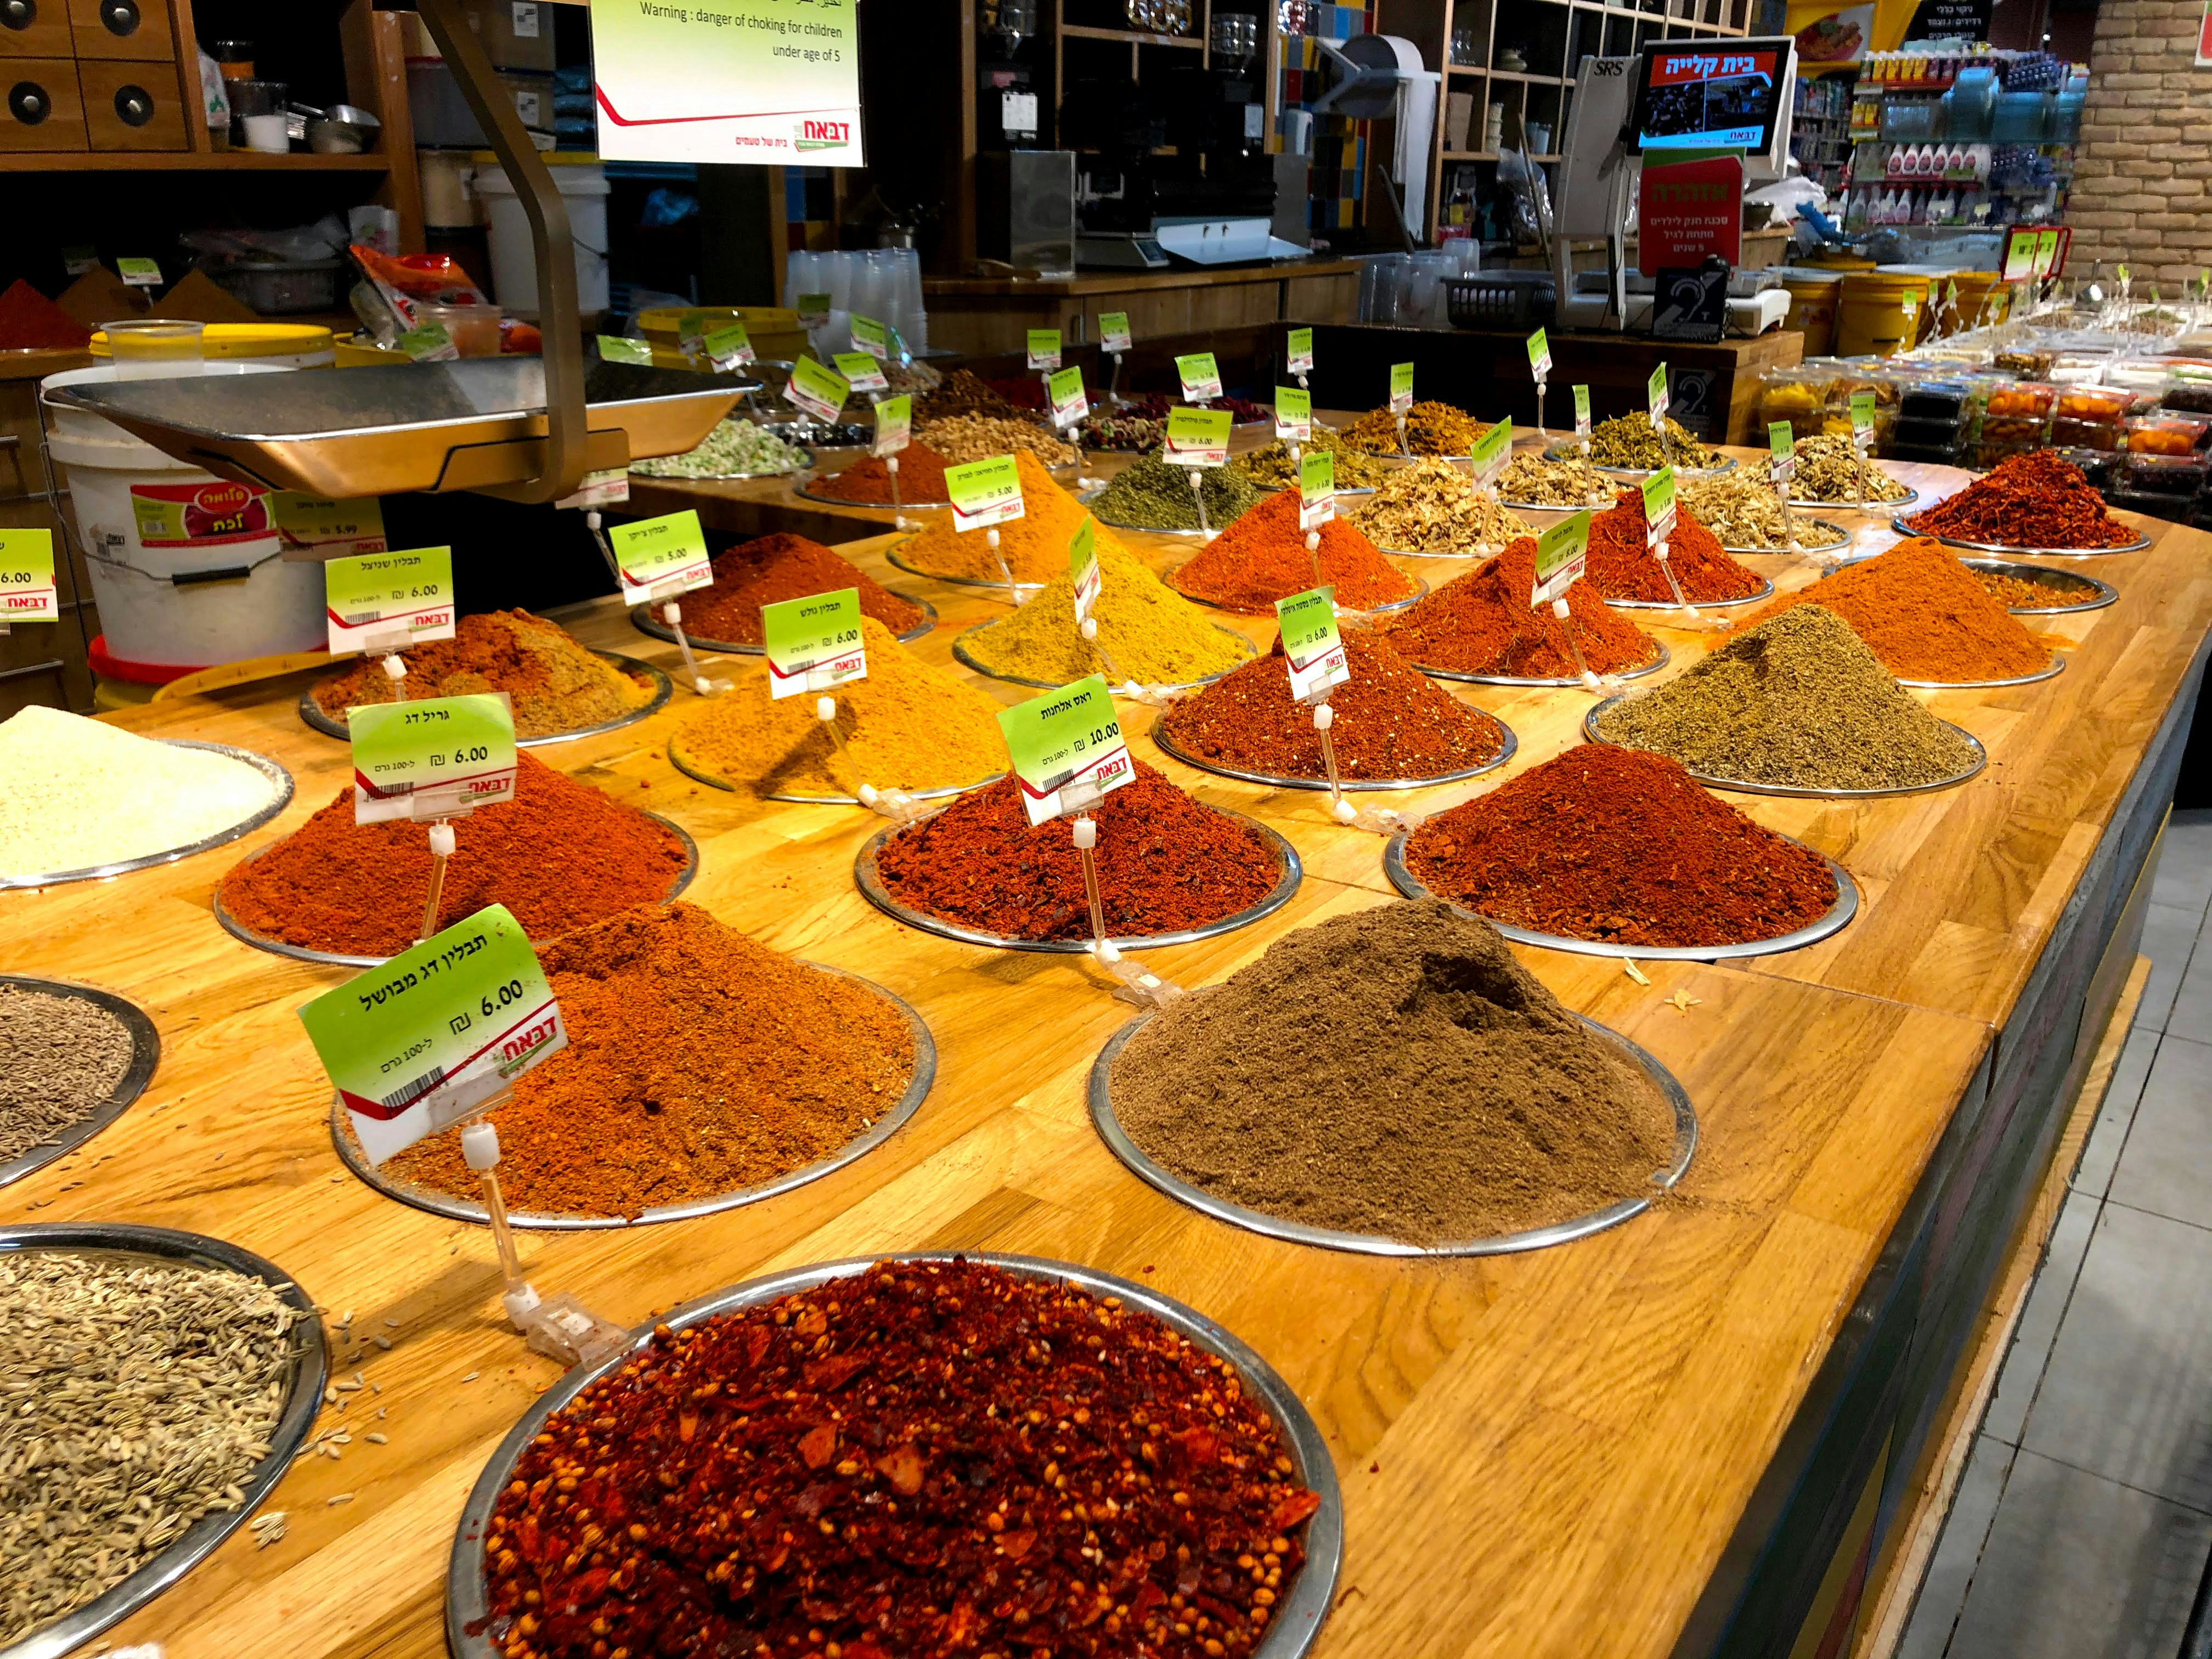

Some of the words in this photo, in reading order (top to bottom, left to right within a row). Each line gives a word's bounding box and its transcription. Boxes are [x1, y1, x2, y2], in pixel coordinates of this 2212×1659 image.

[640, 1, 687, 22] Warning
[696, 9, 732, 27] danger
[735, 14, 746, 27] of
[747, 16, 786, 35] choking
[788, 20, 802, 33] for
[804, 23, 843, 38] children
[772, 44, 800, 59] under
[803, 49, 820, 63] age
[822, 49, 834, 61] of
[834, 50, 840, 62] 5
[1593, 60, 1624, 76] SRS
[1665, 55, 1718, 78] קלייה
[1721, 55, 1755, 73] בית
[804, 120, 849, 140] דבאח
[1652, 184, 1729, 202] אזהרה
[668, 548, 687, 561] 5.00
[361, 560, 391, 571] שניצל
[393, 557, 421, 569] תבלין
[1, 572, 31, 583] 6.00
[392, 590, 404, 600] ₪
[411, 584, 438, 597] 6.00
[8, 597, 48, 607] דבאח
[820, 602, 841, 615] תבלין
[1309, 596, 1322, 608] תבלין
[415, 613, 449, 625] דבאח
[837, 629, 857, 643] 6.00
[1306, 634, 1313, 642] ₪
[1314, 627, 1328, 640] 6.00
[822, 637, 832, 647] ₪
[834, 657, 861, 672] דבאח
[1325, 654, 1344, 668] דבאח
[1073, 691, 1092, 706] ראס
[422, 710, 450, 723] גריל
[1040, 700, 1072, 720] אלחנות
[405, 713, 419, 725] דג
[1090, 722, 1119, 746] 10.00
[1074, 739, 1085, 752] ₪
[430, 754, 445, 766] ₪
[455, 746, 488, 764] 6.00
[1042, 756, 1053, 765] גרם
[1054, 748, 1069, 760] ל-100
[375, 764, 391, 772] גרם
[393, 760, 415, 770] ל-100
[1097, 757, 1127, 780] דבאח
[469, 777, 511, 793] דבאח
[441, 934, 488, 970] תבלין
[419, 961, 439, 979] דג
[359, 972, 417, 1012] מבושל
[481, 979, 523, 1016] 6.00
[449, 1012, 472, 1035] ₪
[503, 1016, 556, 1060] דבאח
[404, 1036, 433, 1062] ל-100
[380, 1056, 402, 1074] גרם
